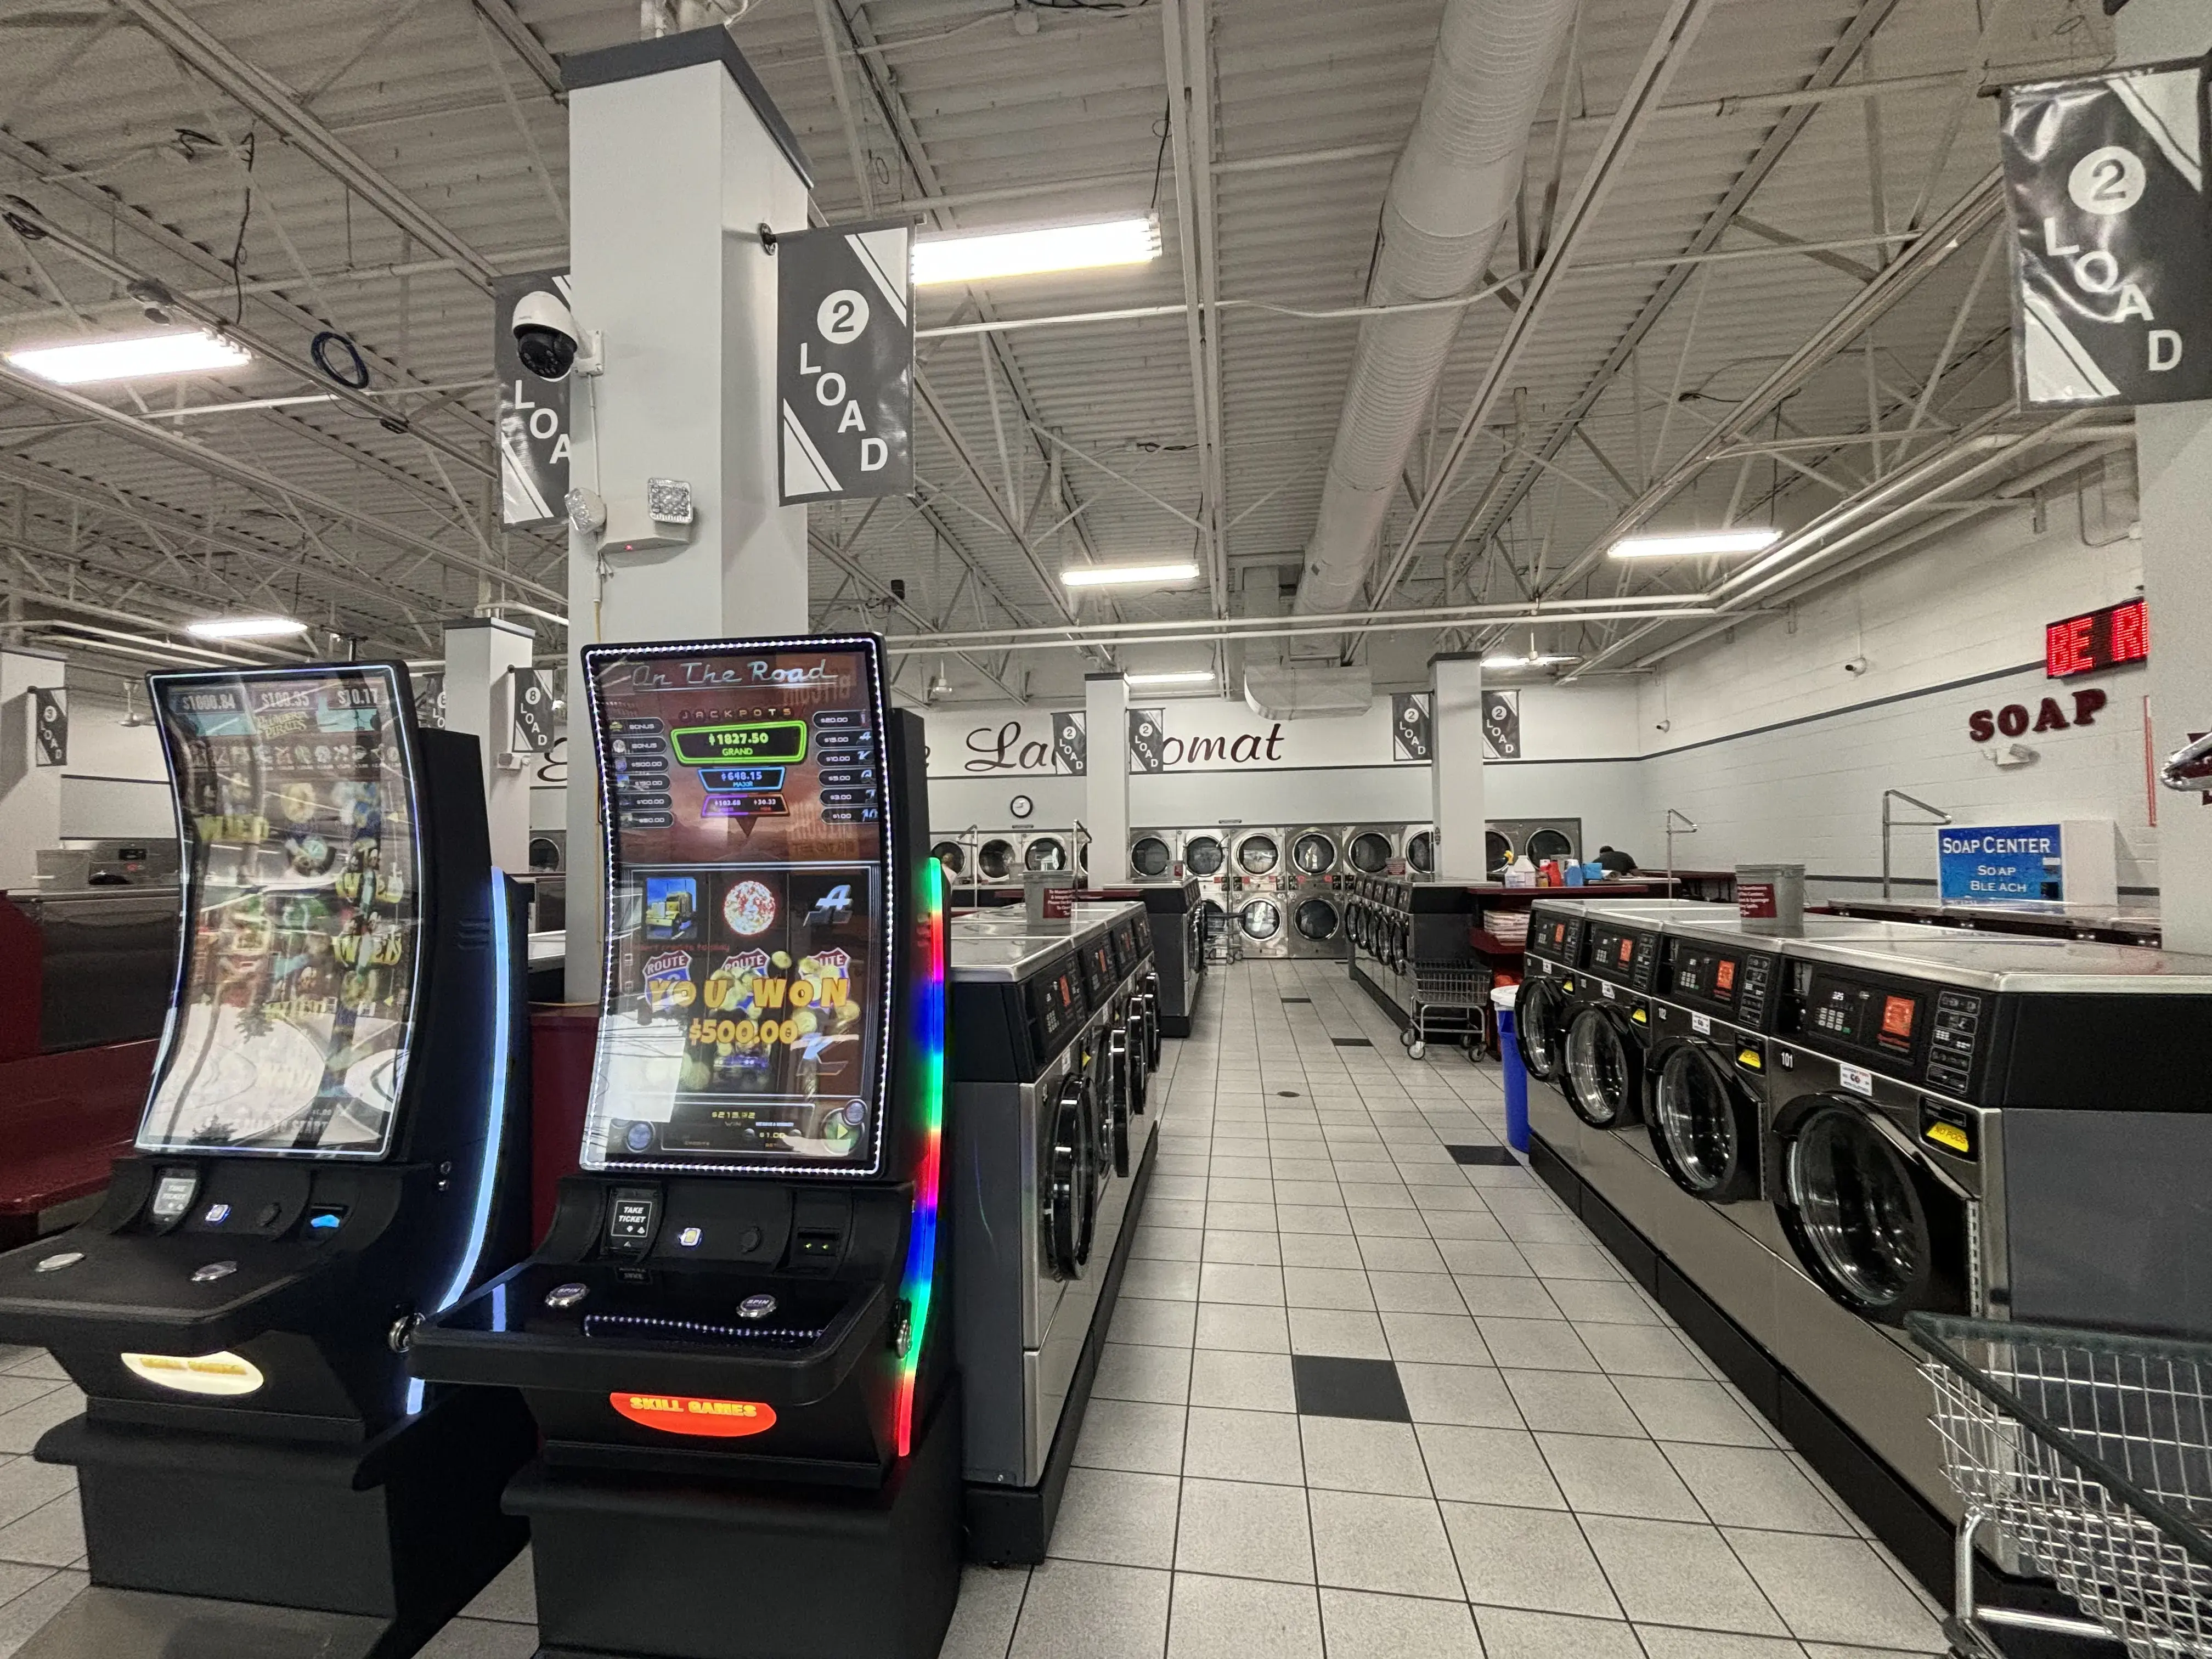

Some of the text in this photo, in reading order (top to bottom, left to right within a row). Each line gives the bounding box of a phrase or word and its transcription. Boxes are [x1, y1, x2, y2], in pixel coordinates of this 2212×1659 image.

[2092, 159, 2126, 201] 2
[2044, 217, 2183, 371] LOAD
[832, 300, 855, 334] 2
[515, 380, 570, 464] LOA
[800, 343, 888, 471] LOAD
[2047, 601, 2149, 676] BE R
[633, 659, 838, 685] On The Road
[521, 703, 547, 746] LOAD
[1969, 689, 2107, 742] SOAP
[40, 720, 63, 759] LOAD
[709, 732, 769, 746] $1827.50
[722, 747, 753, 756] GRAND
[1135, 735, 1158, 767] LOAD
[1399, 721, 1426, 755] LOAD
[1487, 719, 1514, 753] LOAD
[1059, 738, 1084, 770] LOAD
[721, 771, 763, 781] $648.15
[647, 955, 686, 974] ROUTE
[648, 977, 849, 1013] YOU WON
[689, 1017, 798, 1046] $500.00
[1781, 1052, 1793, 1068] 101
[630, 1397, 757, 1417] SKILL GAMES
